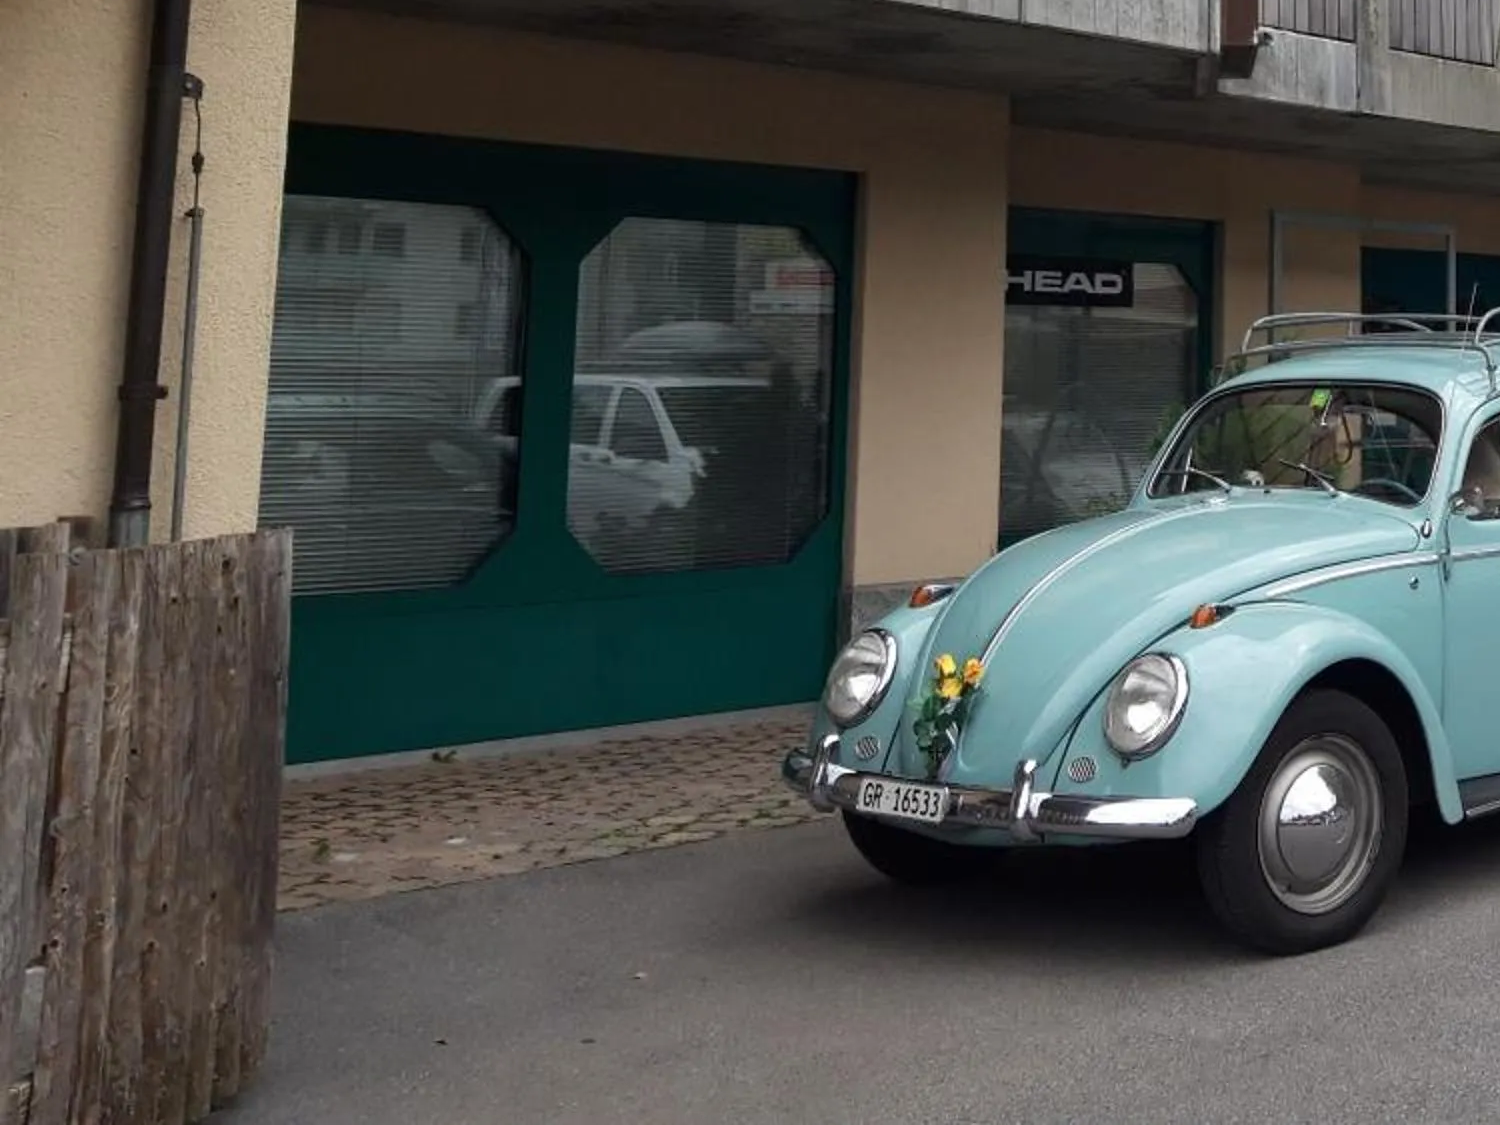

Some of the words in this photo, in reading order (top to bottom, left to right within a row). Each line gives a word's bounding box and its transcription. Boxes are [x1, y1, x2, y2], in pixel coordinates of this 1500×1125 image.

[1006, 270, 1123, 294] HEAD
[863, 782, 883, 809] GR
[893, 786, 941, 818] 16533
